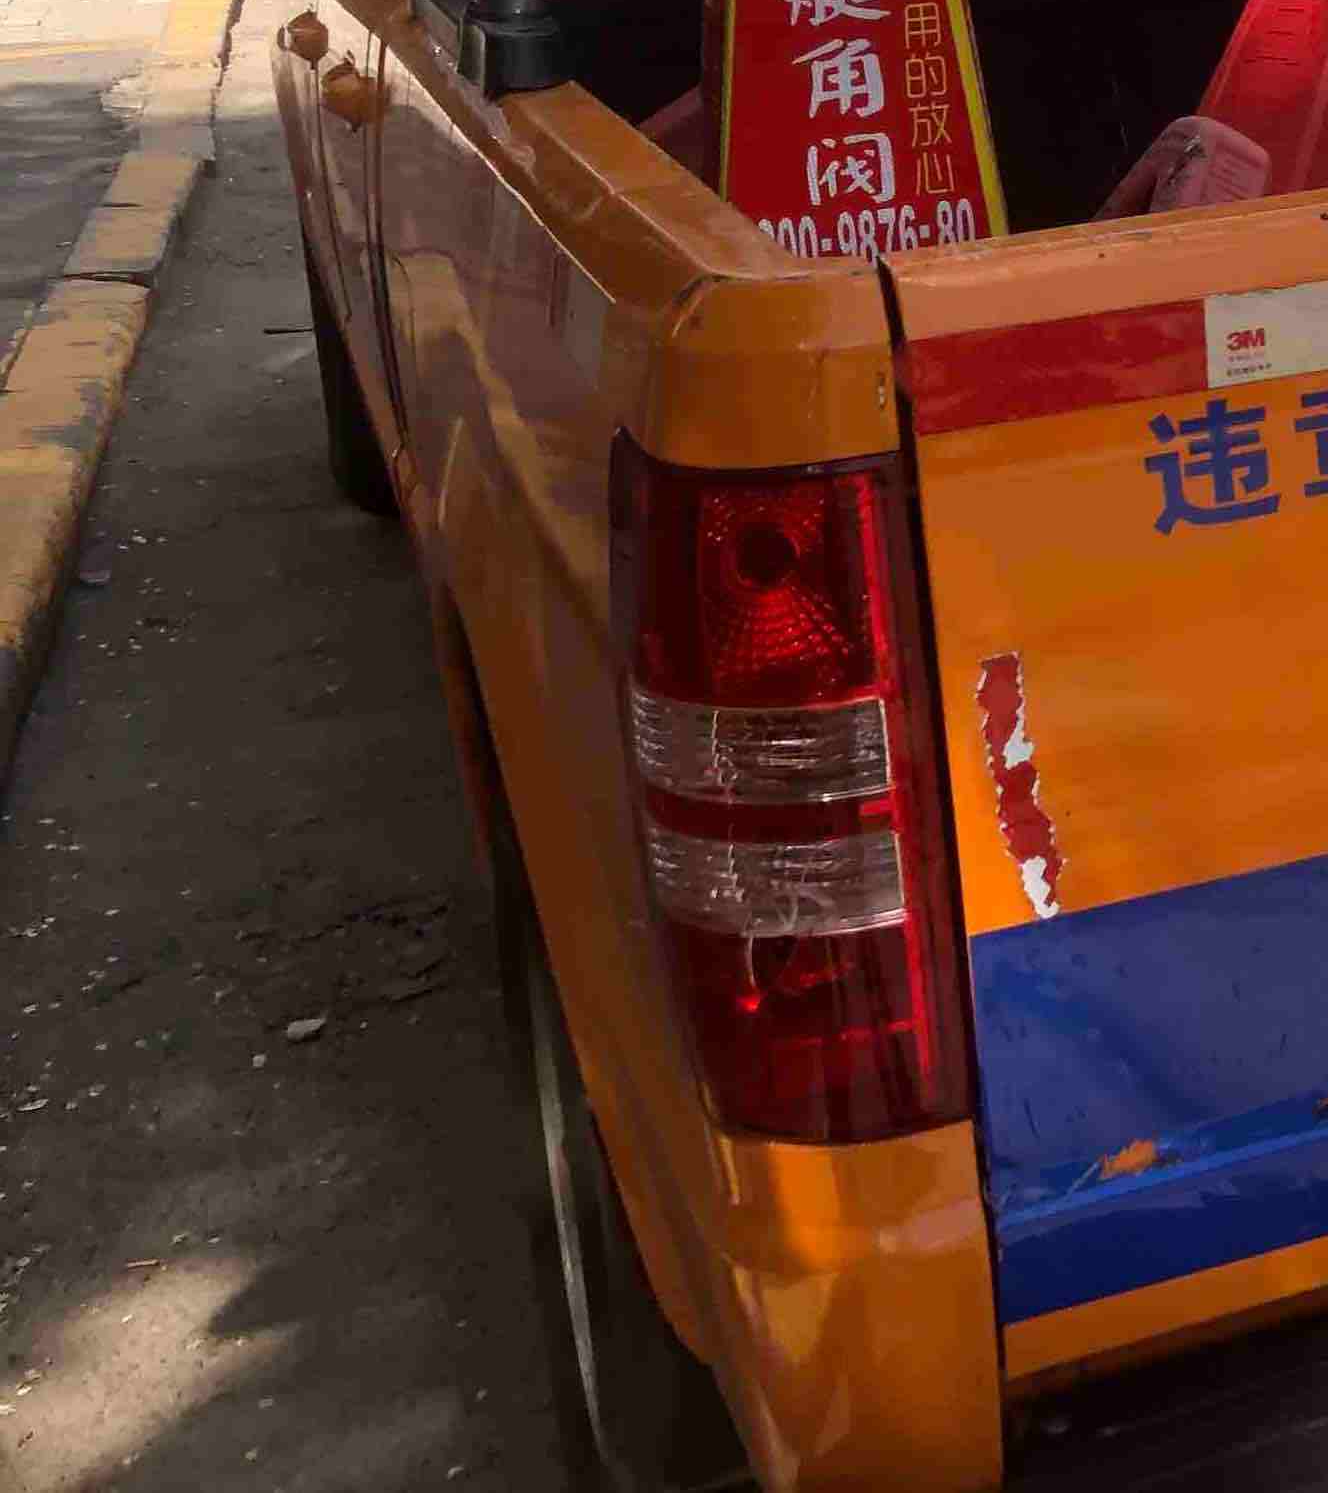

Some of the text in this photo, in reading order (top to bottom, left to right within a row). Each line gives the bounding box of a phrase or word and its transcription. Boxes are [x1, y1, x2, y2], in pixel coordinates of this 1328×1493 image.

[904, 2, 956, 195] 用的放心
[1226, 328, 1265, 351] 3M
